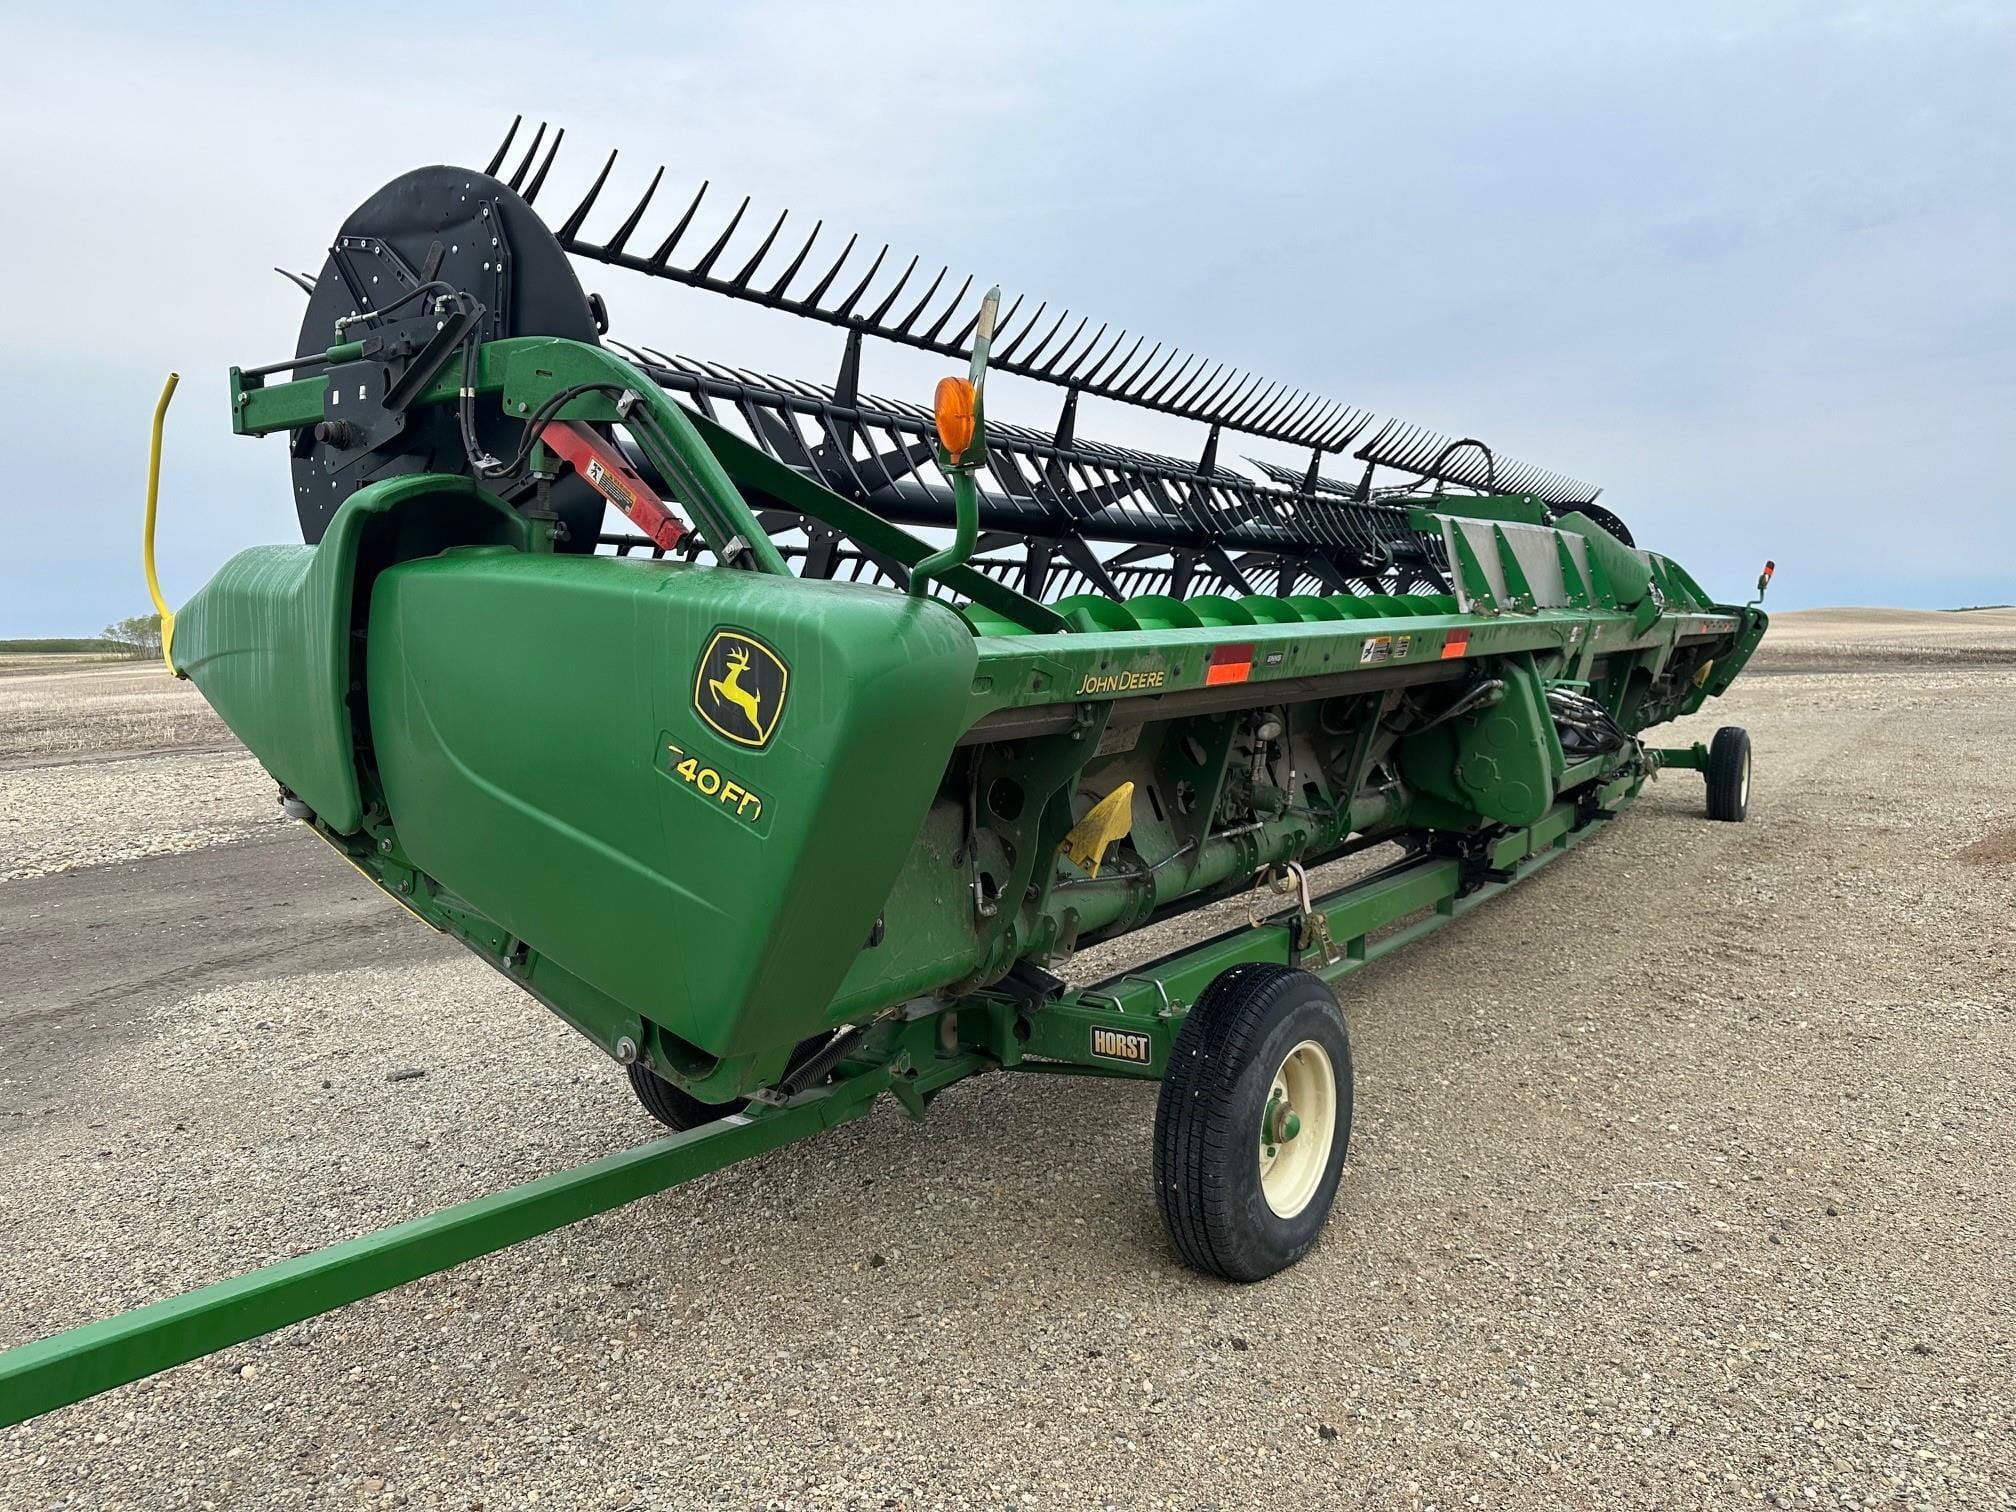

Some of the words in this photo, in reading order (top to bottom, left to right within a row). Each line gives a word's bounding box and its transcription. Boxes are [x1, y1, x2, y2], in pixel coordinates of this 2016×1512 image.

[1076, 674, 1118, 695] JOHN
[1118, 671, 1165, 690] DEERE
[1094, 1030, 1148, 1060] HORST
